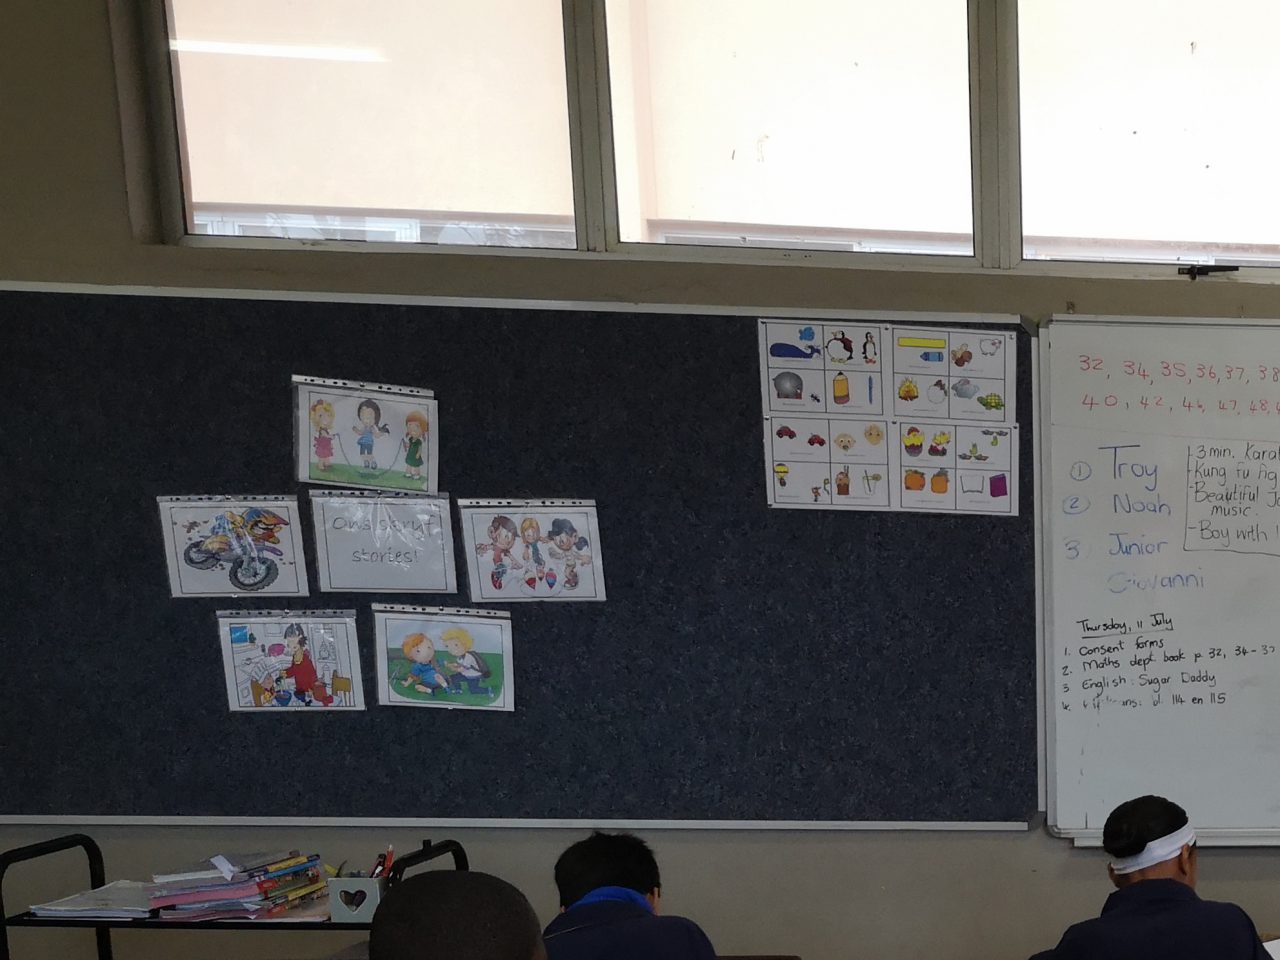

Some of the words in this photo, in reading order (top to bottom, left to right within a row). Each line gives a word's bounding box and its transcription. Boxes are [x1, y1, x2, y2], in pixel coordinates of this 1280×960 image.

[1258, 365, 1280, 382] 38
[1098, 444, 1158, 492] Troy
[1195, 460, 1226, 486] Kung
[1194, 480, 1259, 503] Beautiful
[1113, 492, 1172, 516] Noah
[1109, 532, 1169, 556] Junior
[1199, 519, 1230, 548] Boy
[1236, 523, 1268, 542] with
[352, 547, 418, 563] stories!
[1150, 612, 1174, 631] July
[1079, 640, 1125, 656] Consent
[1135, 635, 1164, 650] forms
[1082, 657, 1121, 672] Maths
[1129, 651, 1156, 671] dept
[1163, 648, 1186, 662] book
[1139, 674, 1171, 693] Sugar
[1181, 670, 1217, 688] Daddy
[1210, 692, 1226, 704] 115
